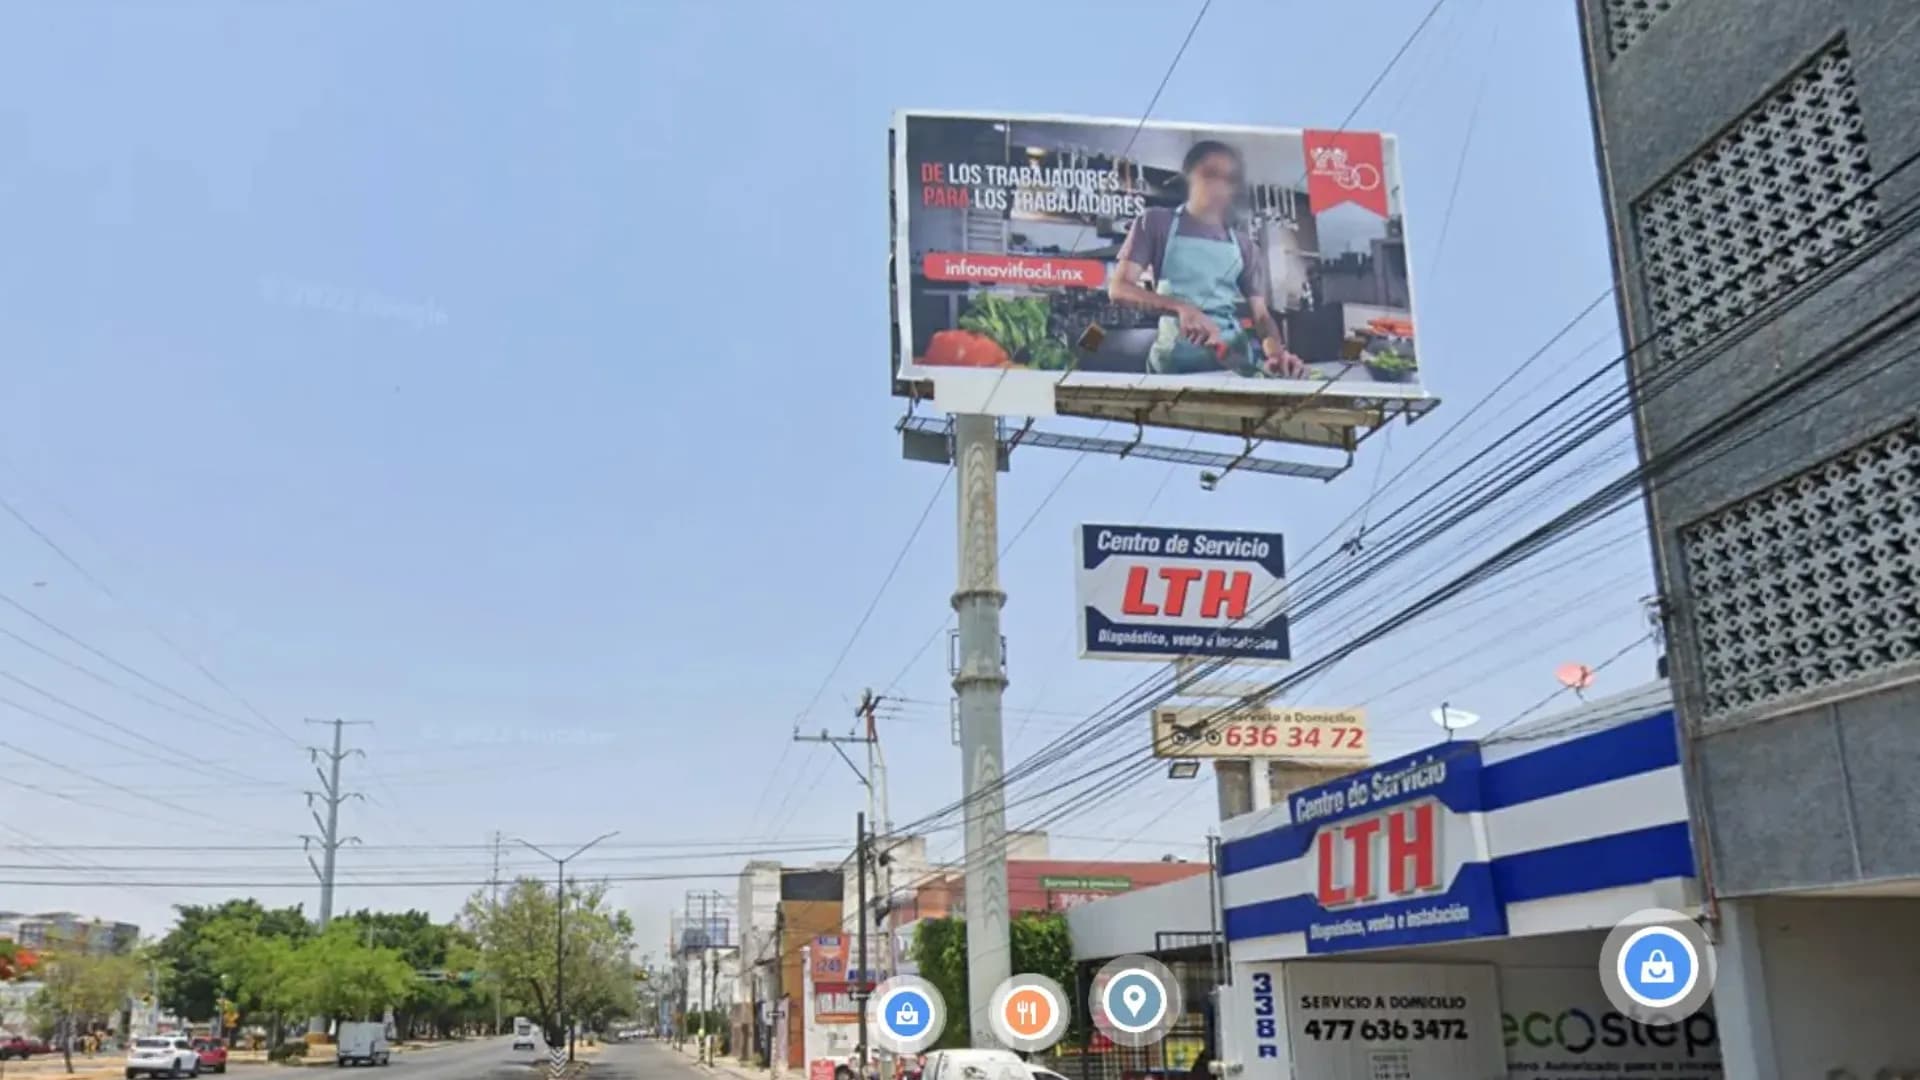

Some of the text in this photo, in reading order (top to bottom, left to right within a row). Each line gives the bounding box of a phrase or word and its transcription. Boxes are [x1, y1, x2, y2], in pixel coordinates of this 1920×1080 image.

[921, 162, 1119, 191] DE LOS TRABAJADORES
[923, 187, 1145, 216] PARA LOS TRABAJADORES
[1097, 530, 1269, 558] Centro de Servicio
[1121, 566, 1253, 620] LTH
[1226, 726, 1364, 748] 636 34 72
[1296, 756, 1446, 823] Centro de Servicio
[1317, 804, 1444, 909] LTH
[1301, 996, 1467, 1009] SERVICIO A DOMICILIO
[1304, 1020, 1468, 1041] 477 636 3472
